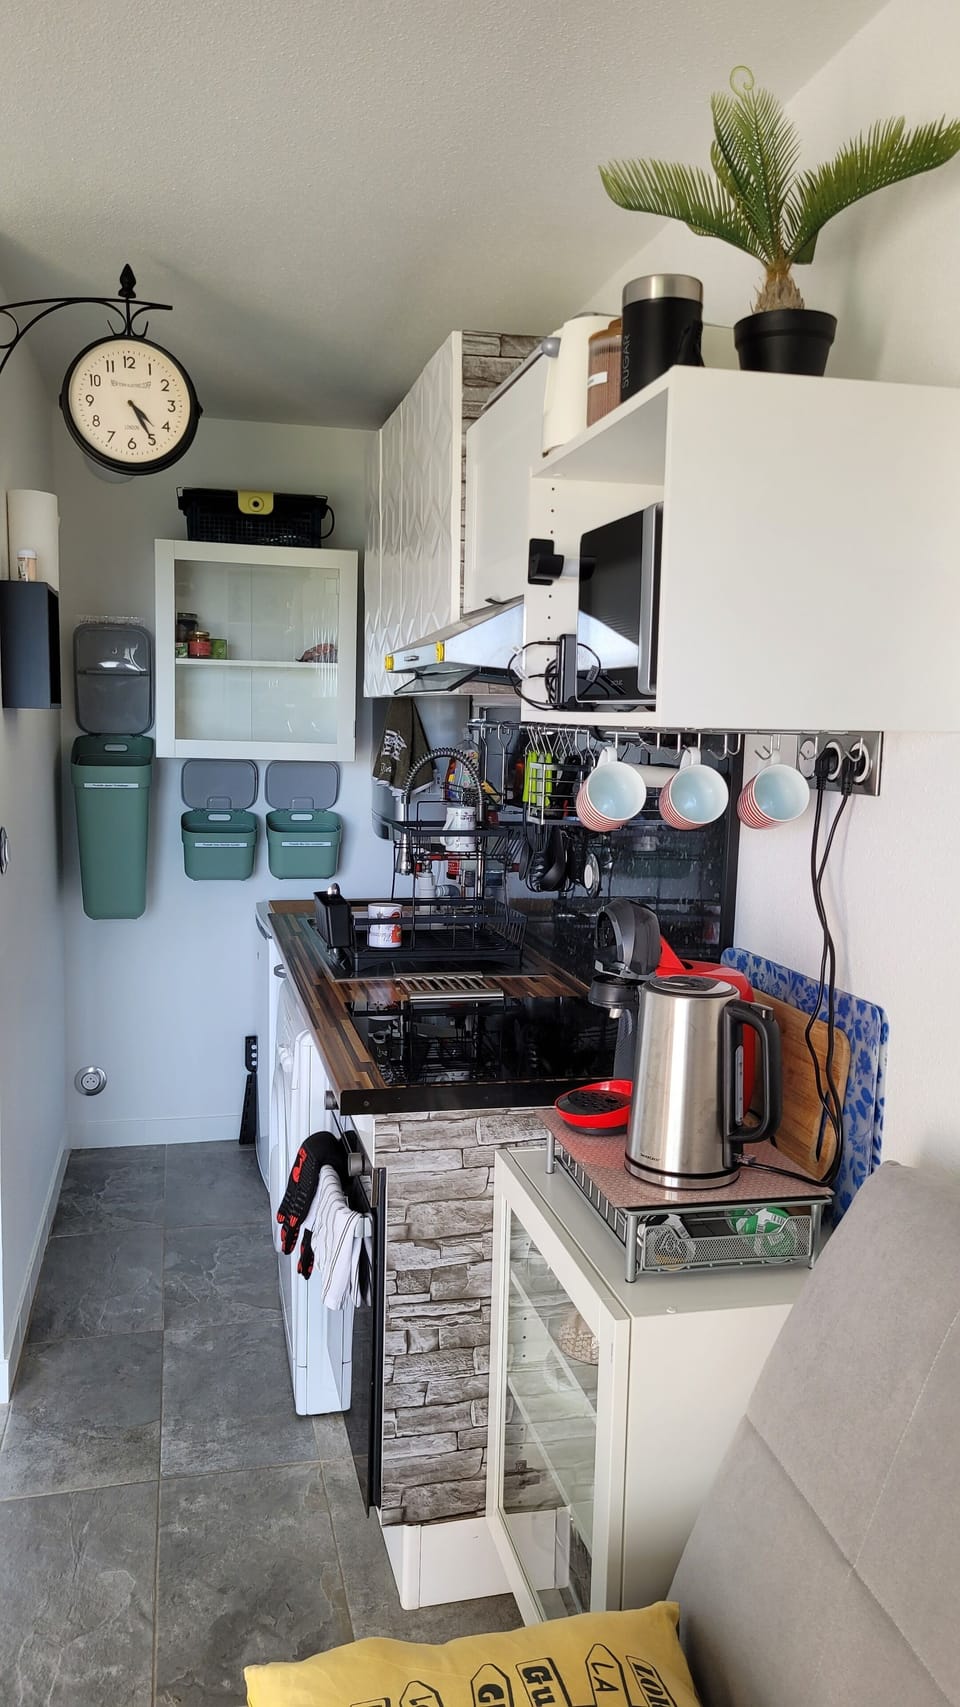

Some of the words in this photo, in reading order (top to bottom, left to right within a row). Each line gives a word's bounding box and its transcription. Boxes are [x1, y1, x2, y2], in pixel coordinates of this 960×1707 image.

[106, 359, 115, 373] 11
[123, 355, 136, 369] 12
[622, 334, 631, 388] SUGAR
[148, 363, 152, 376] 1
[89, 374, 102, 387] 10
[160, 379, 170, 392] 2
[85, 394, 95, 406] 9
[167, 399, 176, 413] 3
[91, 414, 101, 427] 8
[162, 421, 170, 432] 4
[107, 430, 116, 443] 7
[147, 433, 157, 446] 5
[127, 437, 137, 450] 6
[590, 1661, 619, 1692] LA
[477, 1683, 506, 1707] G
